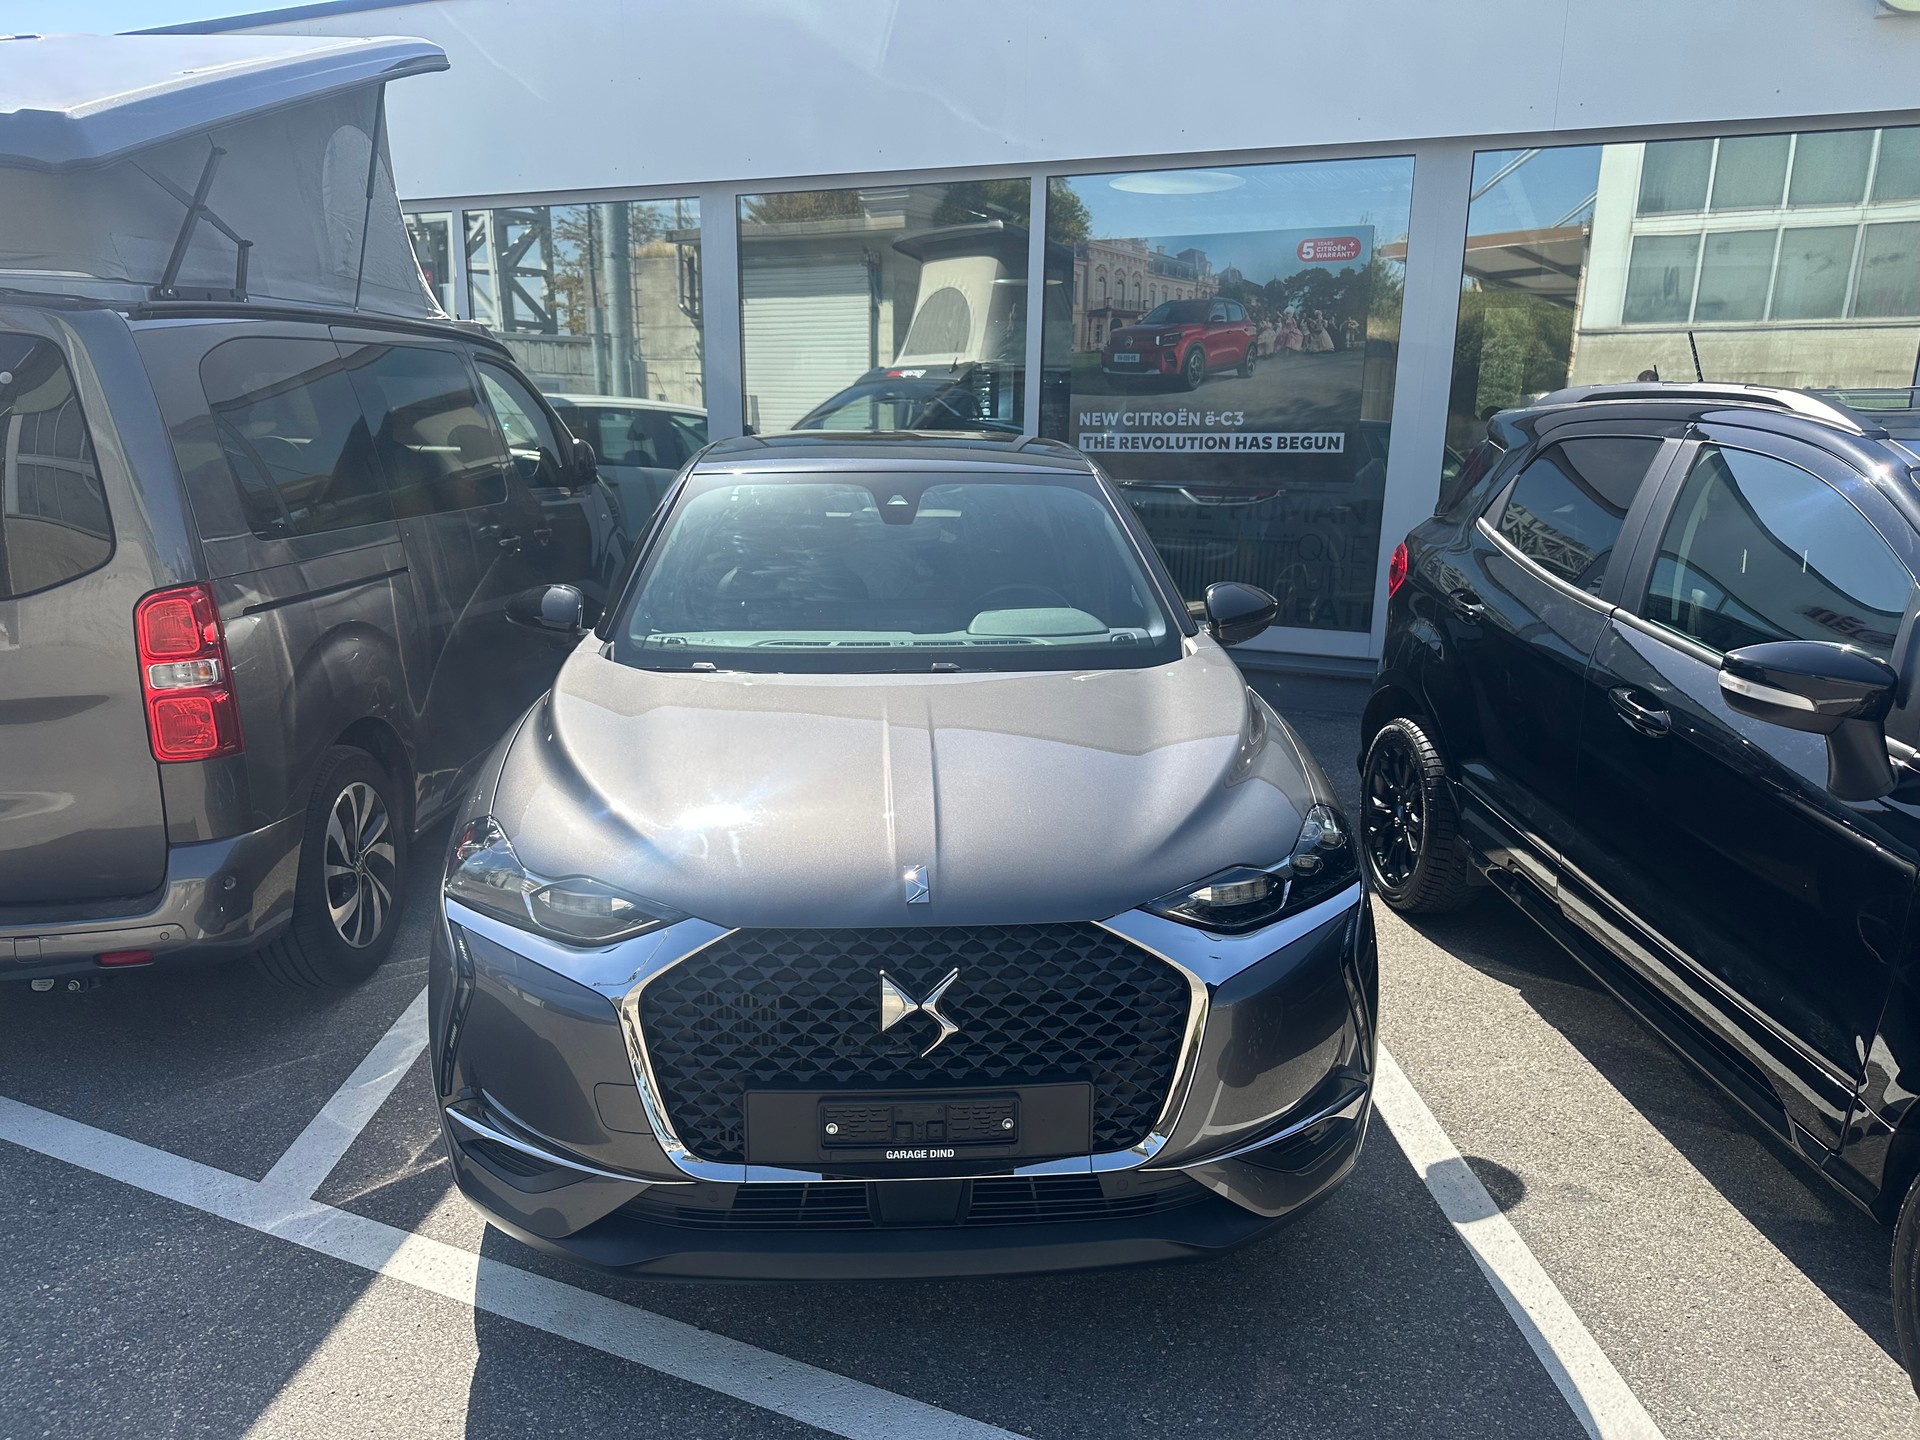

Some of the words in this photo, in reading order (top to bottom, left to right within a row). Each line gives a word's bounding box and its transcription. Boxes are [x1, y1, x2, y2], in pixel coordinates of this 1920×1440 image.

[1302, 242, 1314, 259] 5
[1316, 251, 1356, 259] WARRANTY
[1079, 412, 1119, 426] NEW
[1122, 408, 1200, 426] CITROËN
[1204, 411, 1244, 426] ë-C3
[1083, 436, 1115, 449] THE
[1119, 436, 1230, 450] REVOLUTION
[1235, 436, 1273, 450] HAS
[1276, 436, 1341, 450] BEGUN
[886, 1150, 927, 1159] GARAGE
[929, 1149, 955, 1158] DIND
